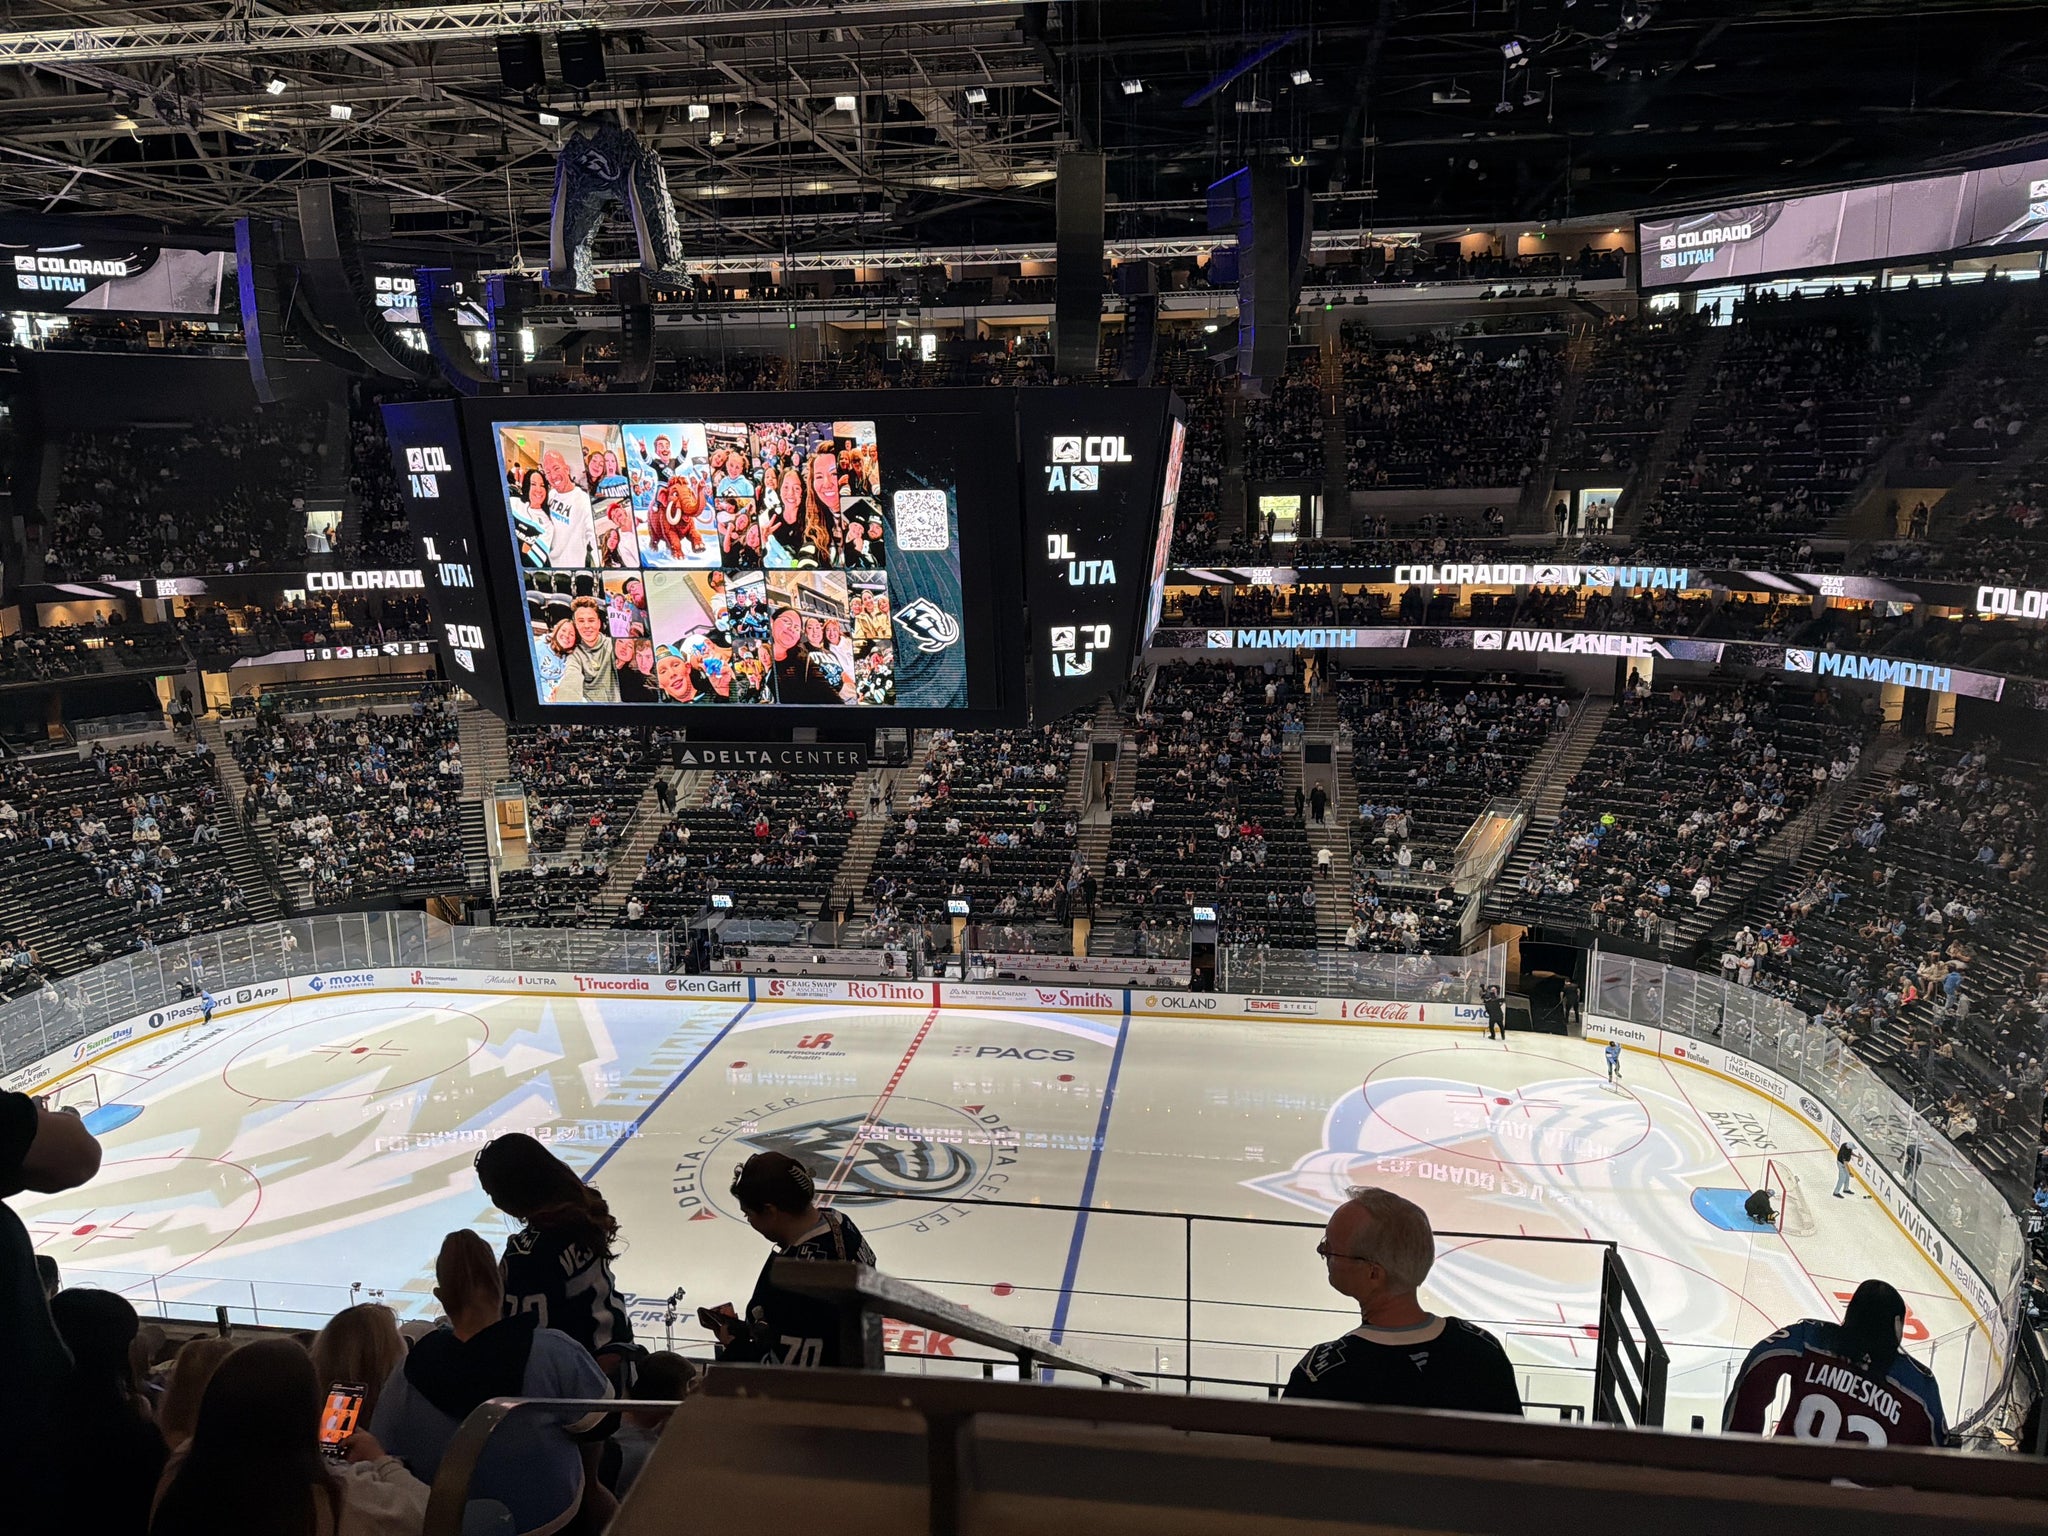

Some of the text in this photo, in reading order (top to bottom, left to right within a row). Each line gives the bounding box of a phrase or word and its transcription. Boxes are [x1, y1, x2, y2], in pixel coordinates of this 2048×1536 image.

[1677, 223, 1752, 249] COLORADO
[1678, 248, 1716, 266] UTAH
[37, 257, 128, 277] COLORADO
[39, 276, 87, 292] UTAH
[1085, 436, 1133, 462] COL
[422, 446, 452, 471] COL
[1252, 568, 1272, 577] SEAT
[1394, 564, 1527, 584] COLORADO
[1619, 566, 1689, 589] UTAH
[1251, 577, 1272, 585] GEEK
[1822, 575, 1846, 587] SEAT
[1820, 586, 1845, 597] GEEK
[1237, 629, 1357, 648] MAMMOTH
[1506, 631, 1655, 657] AVALANCHE
[356, 648, 379, 658] 6:33
[1818, 651, 1951, 693] MAMMOTH
[703, 750, 860, 765] DELTA CENTER
[330, 973, 375, 984] moxie
[525, 977, 557, 986] ULTRA
[585, 977, 650, 991] Trucordia
[678, 979, 742, 993] Ken Garff
[786, 980, 837, 988] CRAIG SWAPP
[1060, 989, 1113, 1008] Smith's
[1162, 997, 1217, 1010] OKLAND
[1251, 1001, 1281, 1010] SME
[86, 1026, 133, 1051] SameDay
[1609, 1026, 1645, 1041] Health
[768, 1049, 846, 1057] Intermountain
[975, 1046, 1076, 1062] PACS
[1687, 1051, 1710, 1065] YouTube
[1729, 1055, 1748, 1068] JUST
[33, 1068, 51, 1081] FIRST
[1728, 1063, 1783, 1095] INGREDIENTS
[1706, 1111, 1751, 1149] BANK
[1732, 1112, 1778, 1150] ZIONS
[673, 1097, 800, 1208] DELTA CENTER
[1898, 1199, 1933, 1254] vivint
[2027, 1220, 2042, 1232] 70
[1804, 1361, 1902, 1426] LANDESKOG
